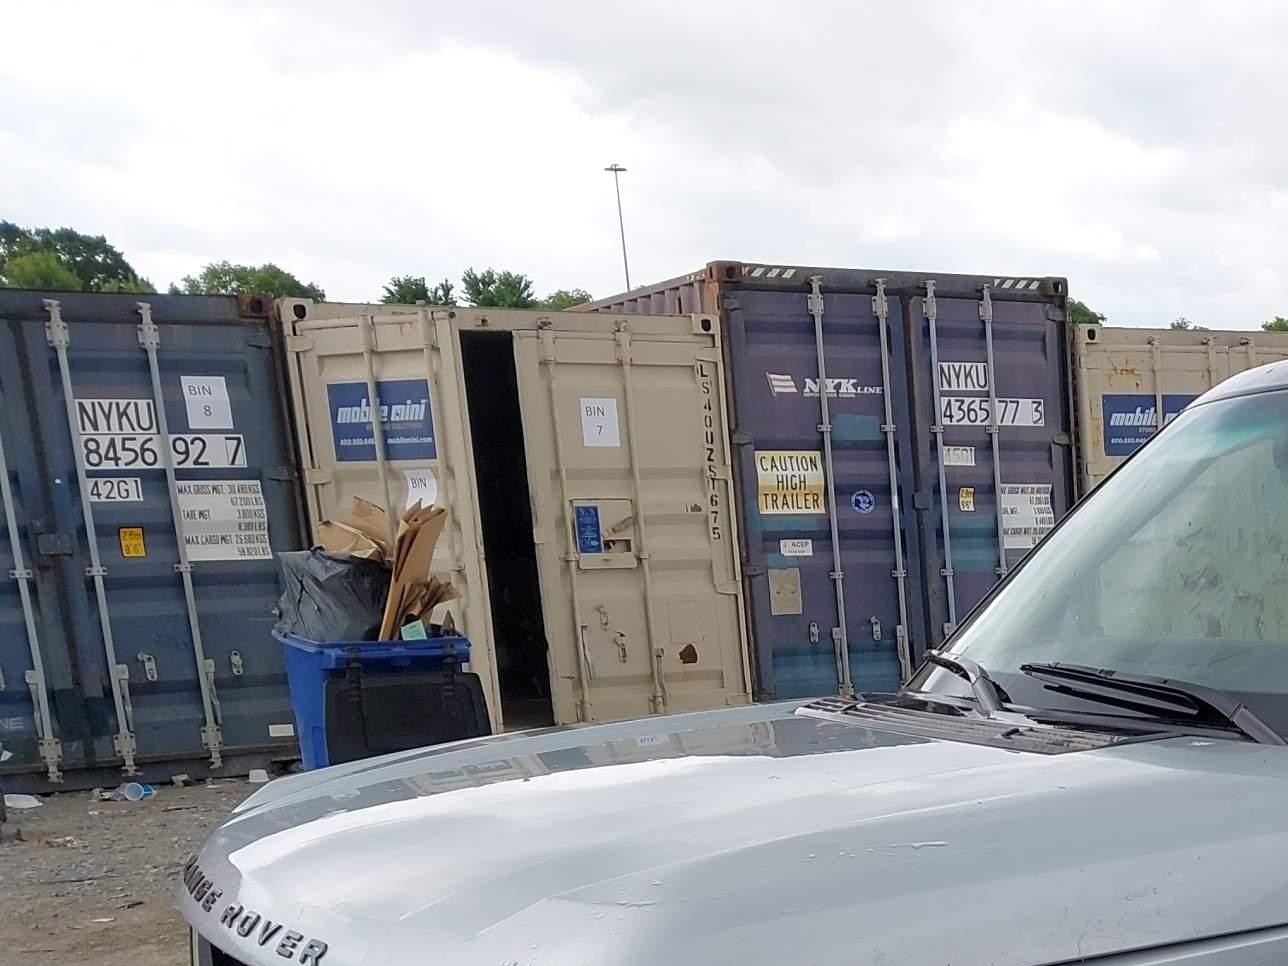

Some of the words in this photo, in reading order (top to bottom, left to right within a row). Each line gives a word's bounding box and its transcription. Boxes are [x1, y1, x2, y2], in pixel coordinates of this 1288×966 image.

[939, 364, 988, 389] NYKU
[187, 384, 213, 397] BIN
[77, 401, 155, 432] NYKU
[202, 404, 212, 417] 8
[336, 398, 388, 424] mobe
[585, 406, 605, 416] BIN
[1032, 401, 1043, 424] 3
[596, 425, 603, 435] 7
[224, 436, 242, 466] 7
[759, 455, 818, 472] CAUTION
[90, 480, 142, 499] 42G1
[410, 478, 427, 488] BIN
[776, 474, 807, 491] HIGH
[762, 492, 820, 510] TRAILER
